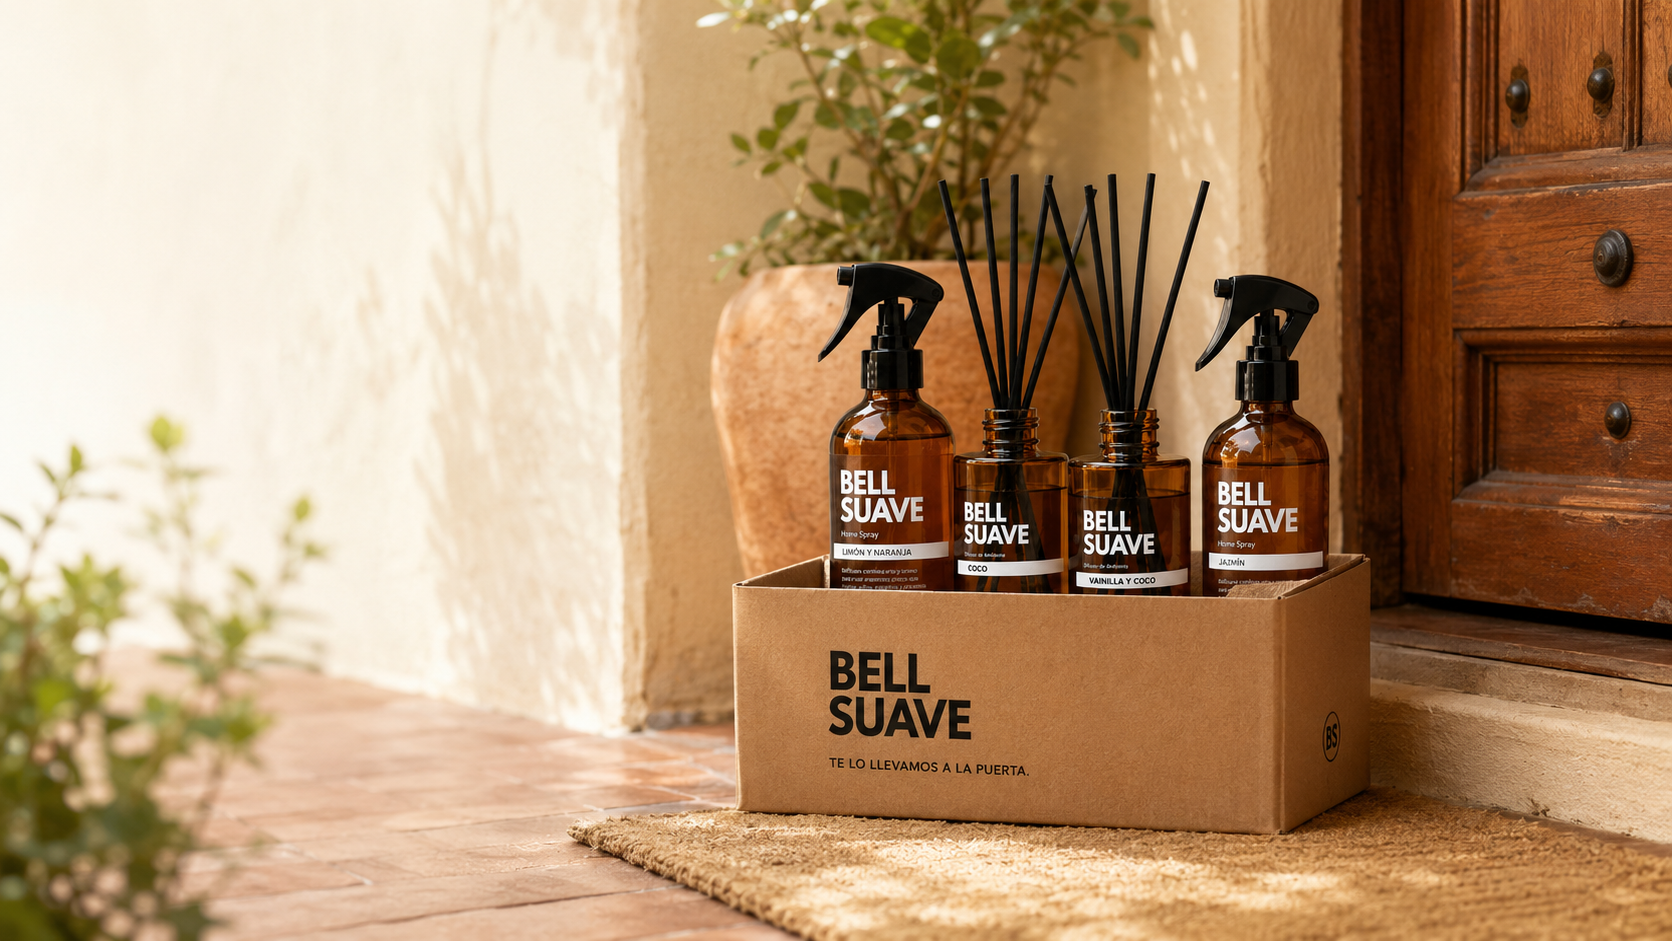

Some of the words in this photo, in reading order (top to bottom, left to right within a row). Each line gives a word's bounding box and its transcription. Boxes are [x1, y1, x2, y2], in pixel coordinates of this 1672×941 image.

[840, 469, 896, 495] BELL
[1218, 481, 1272, 506] BELL
[840, 496, 924, 523] SUAVE
[964, 501, 1007, 522] BELL
[1083, 509, 1131, 532] BELL
[1217, 507, 1298, 533] SUAVE
[859, 530, 879, 540] Spray
[964, 523, 1029, 545] SUAVE
[1083, 533, 1155, 556] SUAVE
[1217, 540, 1235, 548] Home
[1236, 540, 1256, 550] Spray
[842, 548, 865, 556] LIMÓN
[967, 564, 988, 573] COCO
[1089, 577, 1124, 585] VAINILLA
[1133, 577, 1156, 585] COCO
[830, 650, 931, 694] BELL
[828, 695, 972, 740] SUAVE
[1326, 723, 1337, 750] BS
[829, 757, 845, 769] TE
[849, 758, 866, 770] LO
[870, 759, 938, 773] LLEVAMOS
[942, 762, 952, 774] A
[955, 763, 972, 775] LA
[976, 764, 1030, 777] PUERTA.
